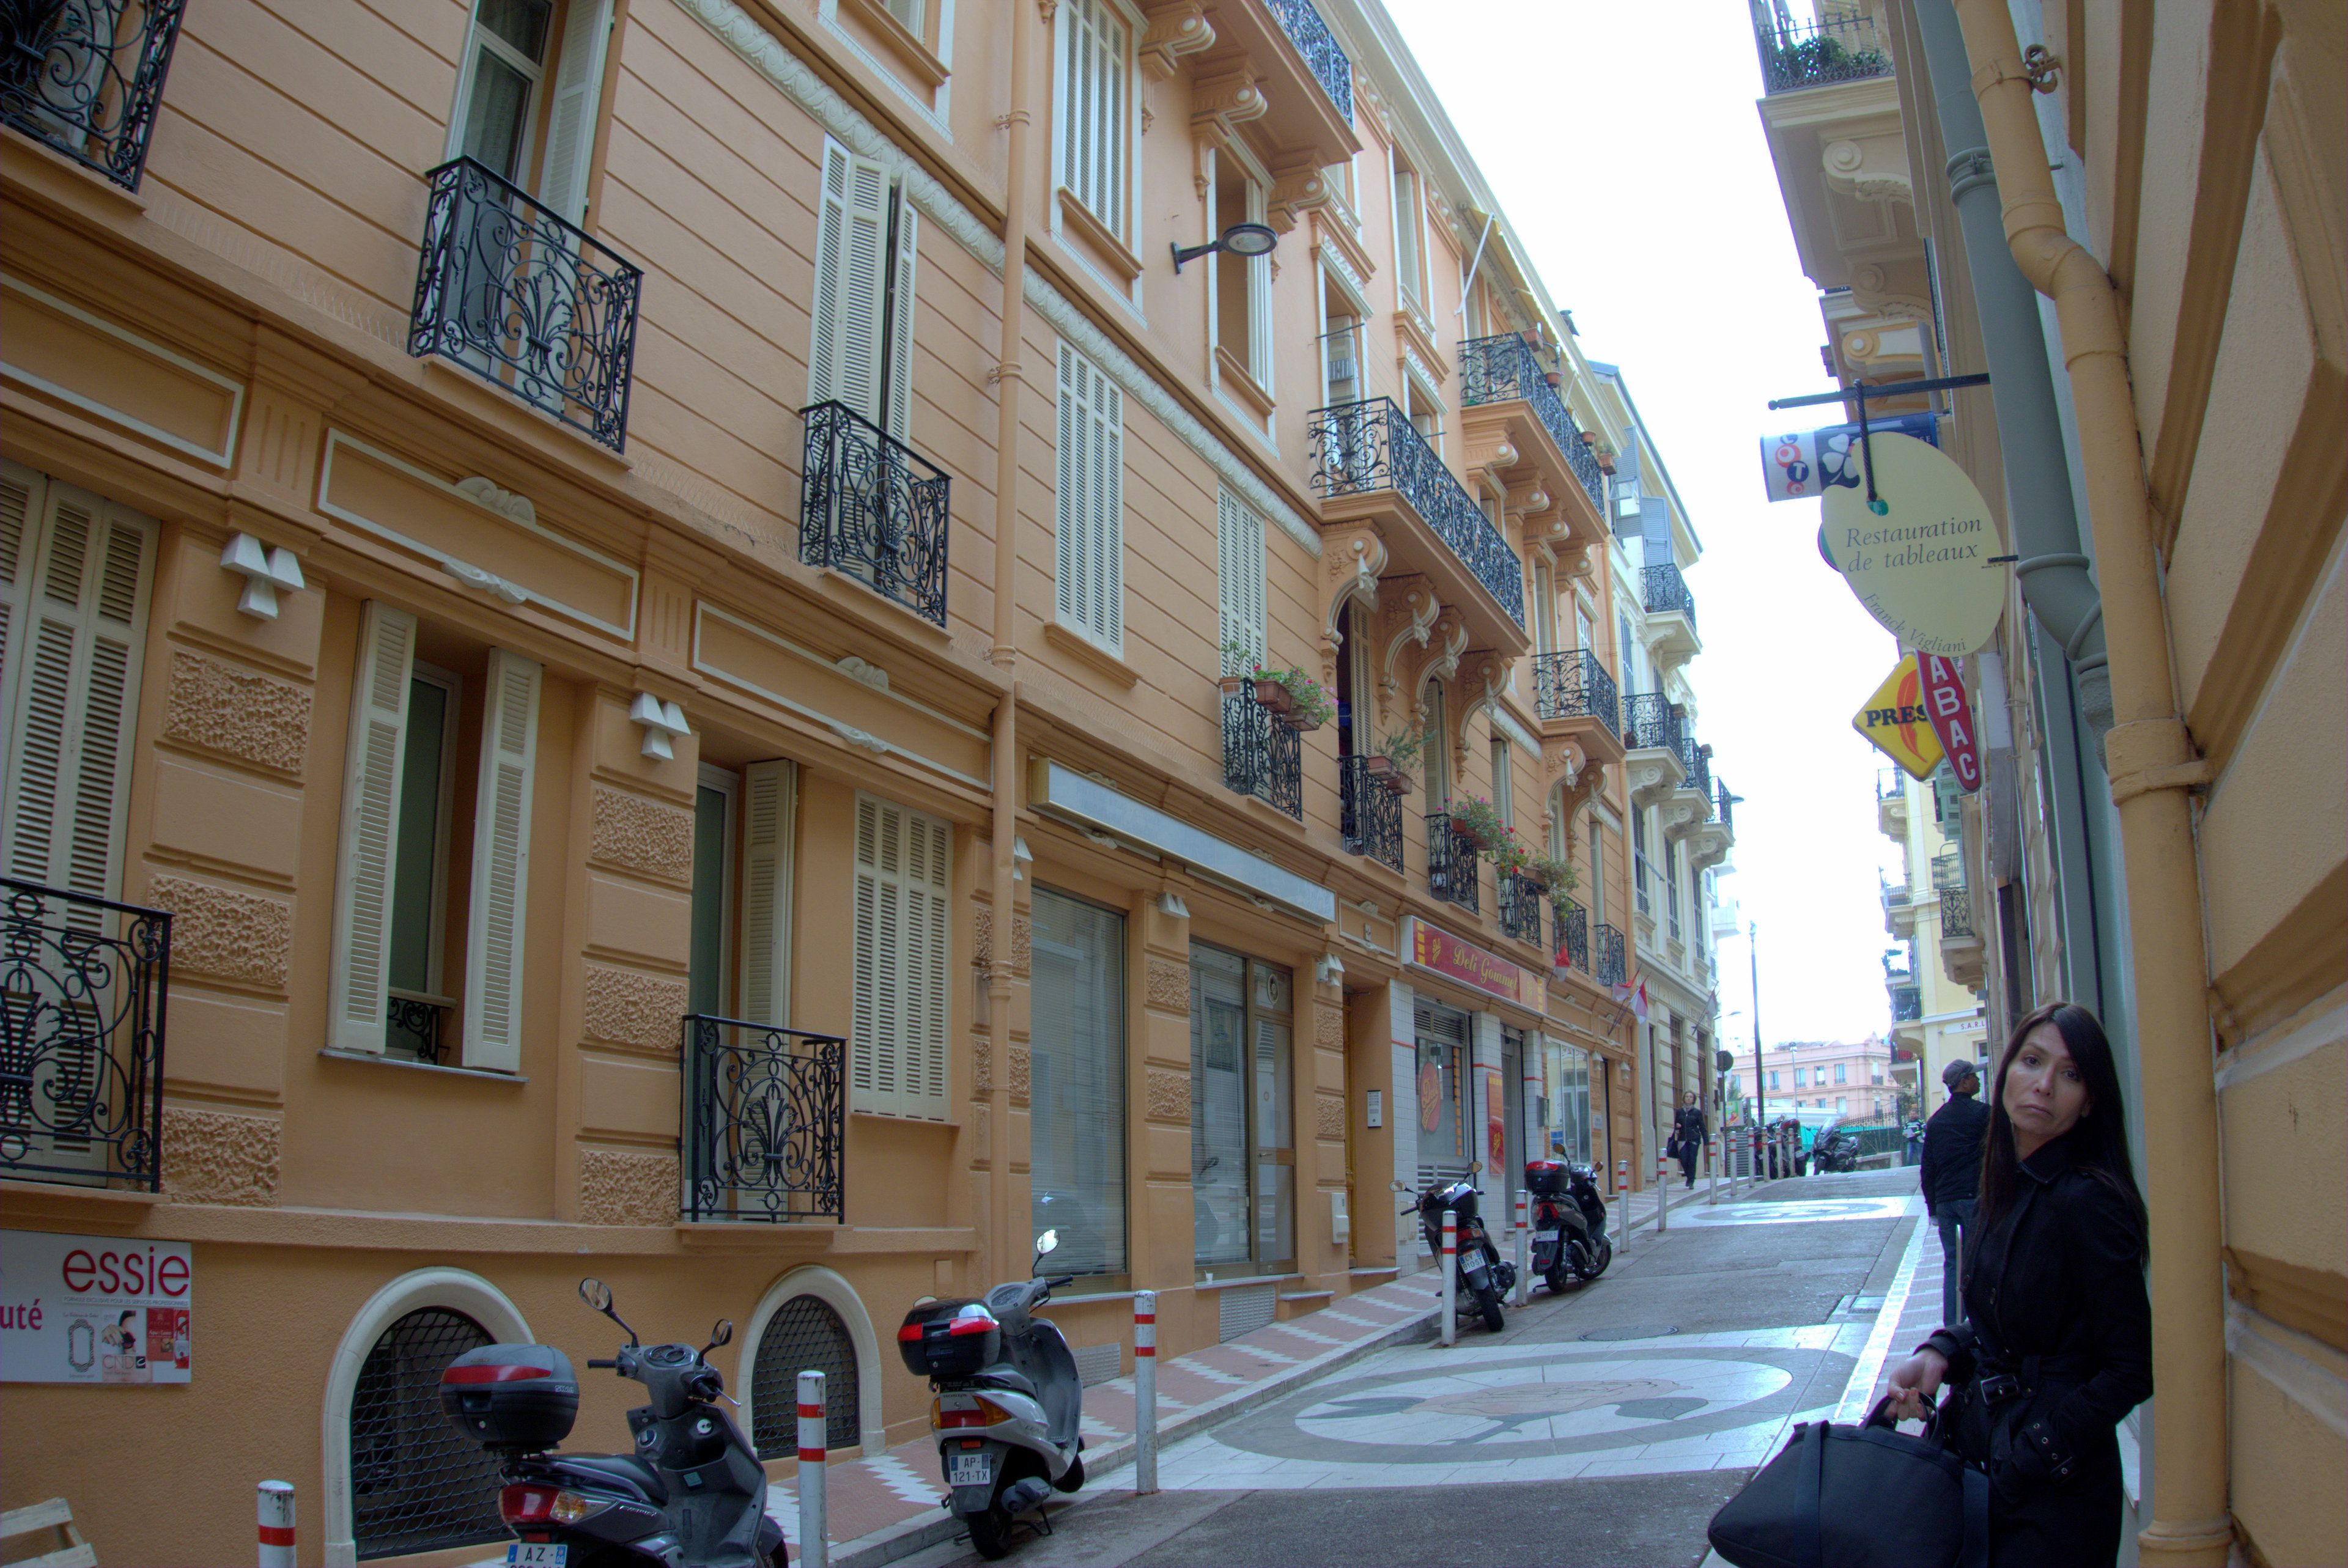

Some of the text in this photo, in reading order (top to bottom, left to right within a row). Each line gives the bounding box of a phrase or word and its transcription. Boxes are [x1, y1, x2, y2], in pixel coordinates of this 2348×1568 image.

[1846, 517, 1982, 548] Restauration
[1848, 543, 1978, 572] de tableaux
[1864, 593, 1966, 652] Franck Vigliani
[1865, 704, 1927, 727] PRES
[1929, 655, 1977, 781] ABAC
[1453, 945, 1478, 973] Deli
[63, 1246, 190, 1297] essie
[103, 1355, 135, 1369] CND
